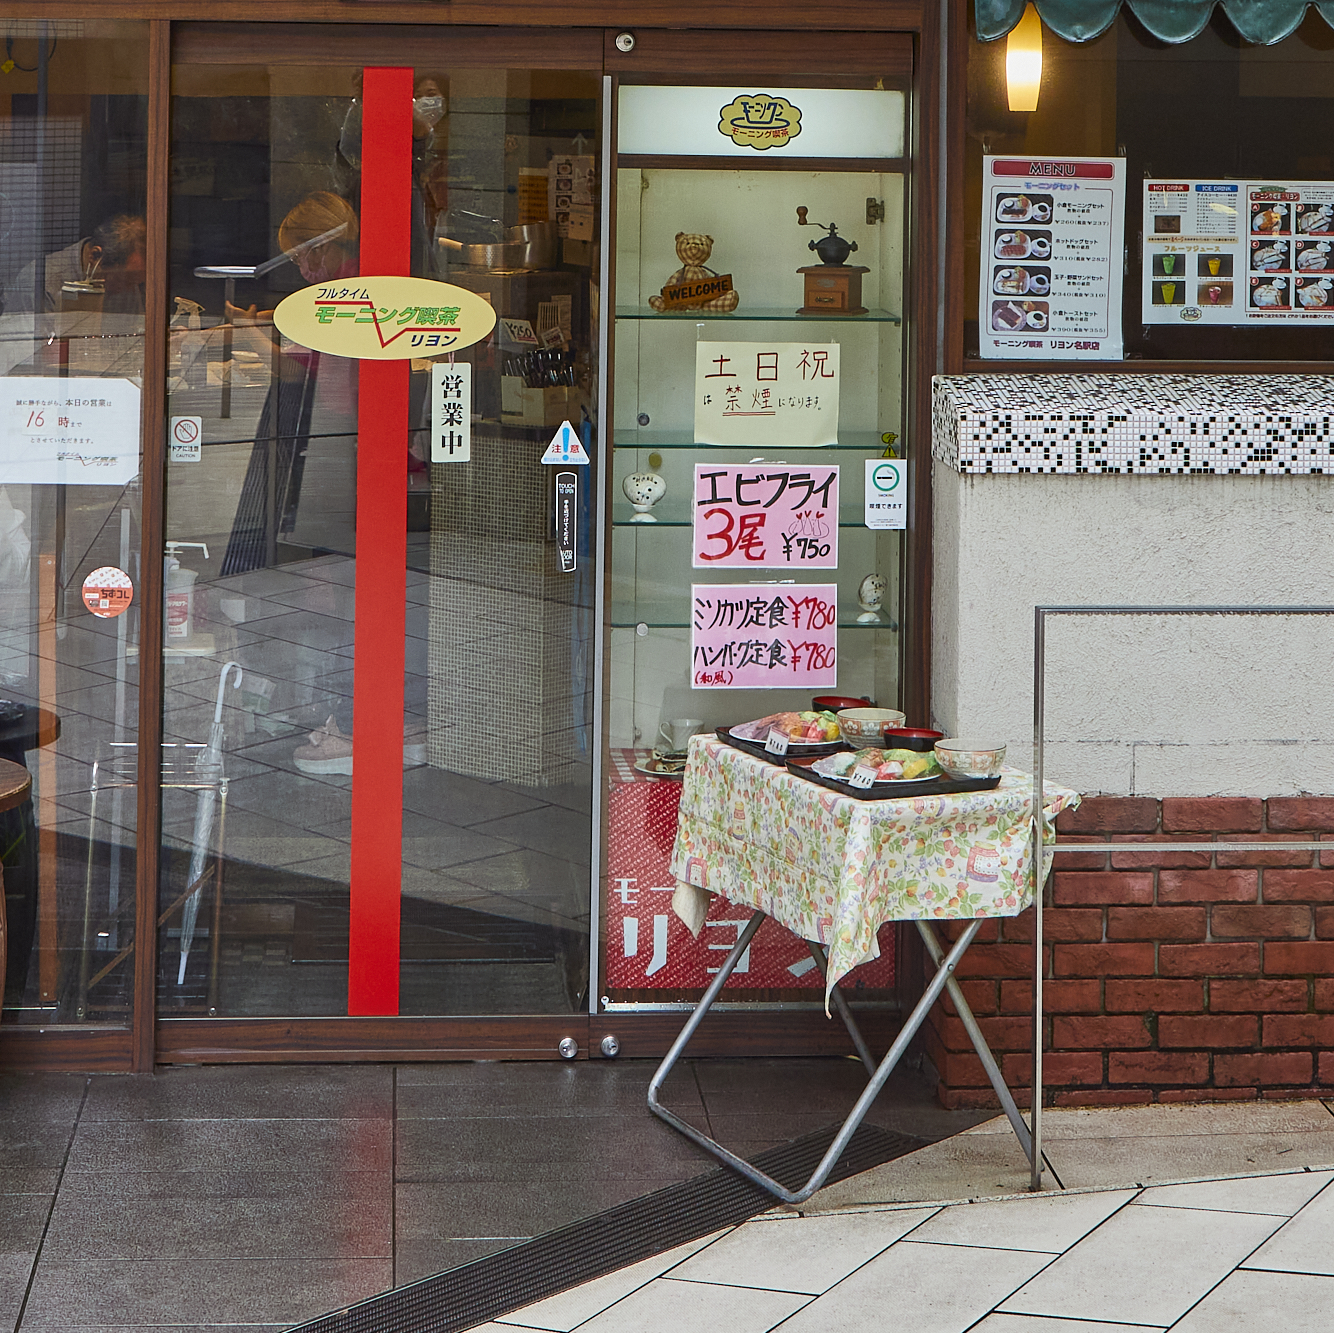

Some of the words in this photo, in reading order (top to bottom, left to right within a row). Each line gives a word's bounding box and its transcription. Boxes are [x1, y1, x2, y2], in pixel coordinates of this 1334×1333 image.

[732, 127, 789, 139] モーニング喫茶
[1029, 162, 1076, 177] MENU
[1024, 182, 1080, 191] モーニングセット
[317, 288, 370, 299] フルタイム
[669, 280, 729, 300] WELCOME
[315, 306, 461, 325] モーニング喫茶
[411, 334, 458, 347] リヨン
[26, 410, 45, 428] 16
[441, 374, 464, 455] 営業中
[697, 471, 837, 510] エビフライ
[698, 508, 767, 561] 3尾
[781, 532, 831, 561] ¥750
[787, 595, 835, 631] ¥780
[786, 639, 835, 671] ¥780
